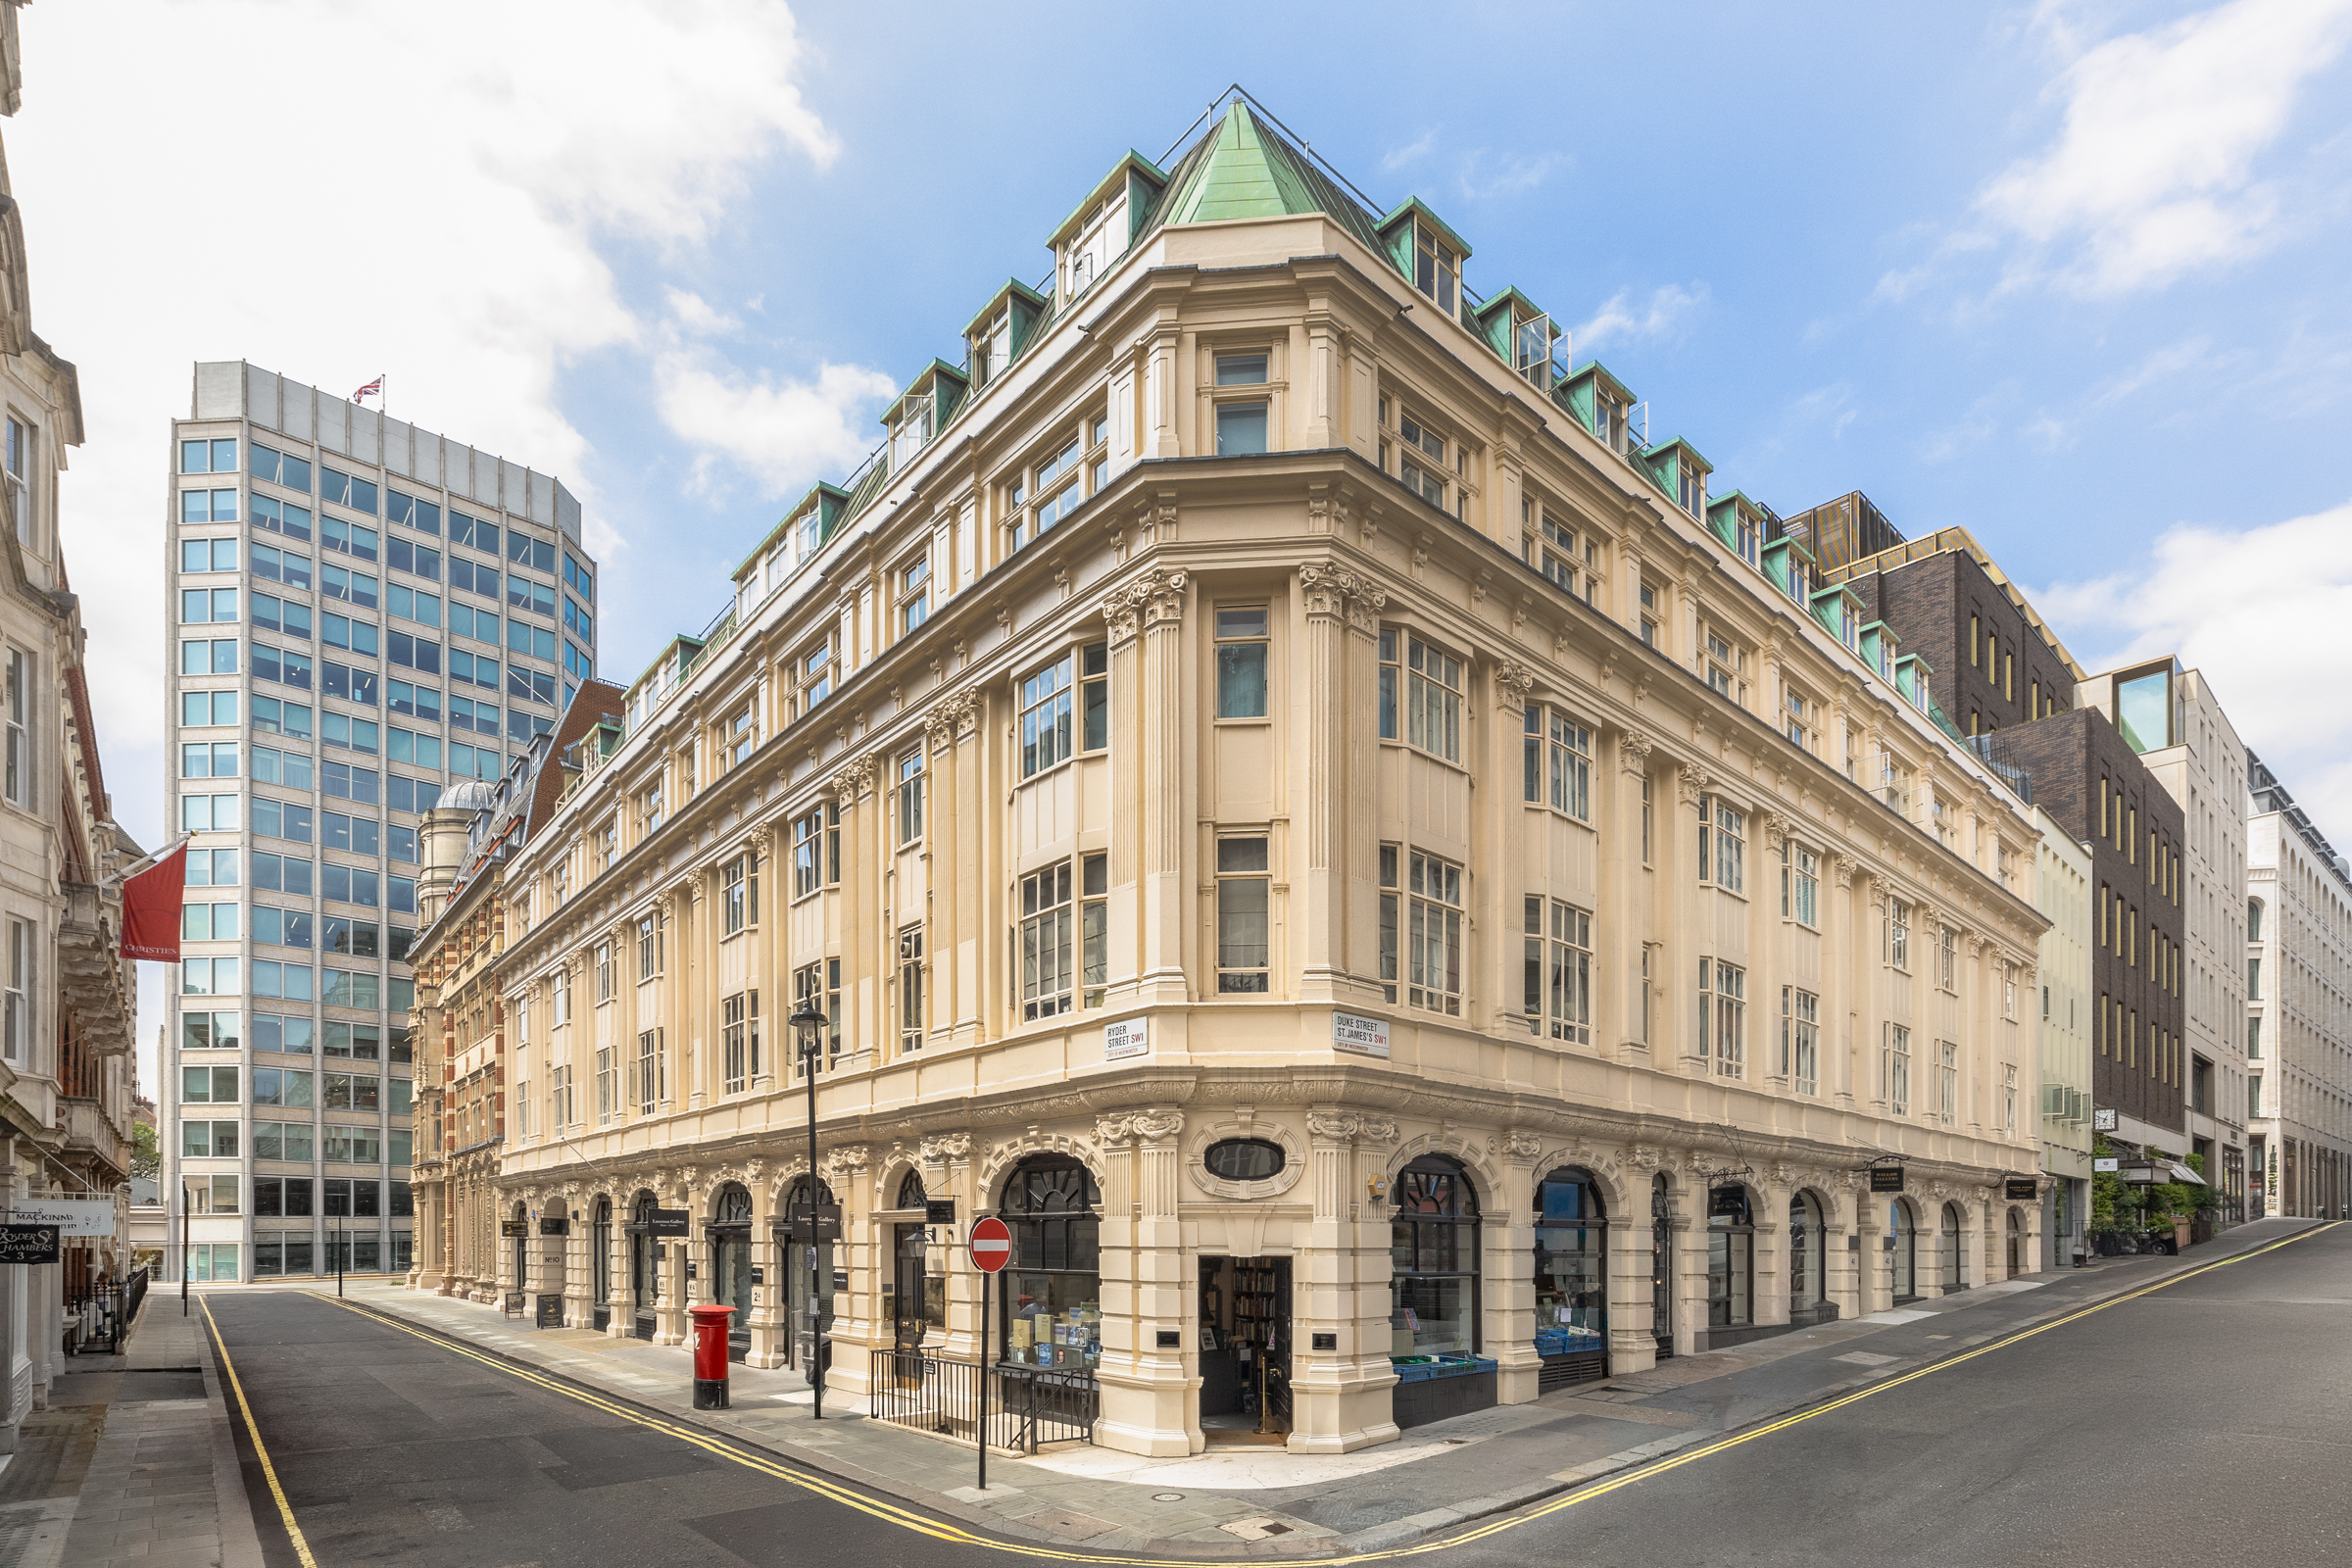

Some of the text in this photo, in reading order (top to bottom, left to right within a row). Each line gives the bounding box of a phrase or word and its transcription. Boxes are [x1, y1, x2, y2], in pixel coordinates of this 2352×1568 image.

[1337, 1015, 1378, 1032] DUKE STREET
[1107, 1025, 1127, 1037] RYDER
[1107, 1032, 1144, 1048] STREET SW1
[1374, 1034, 1387, 1045] SW1
